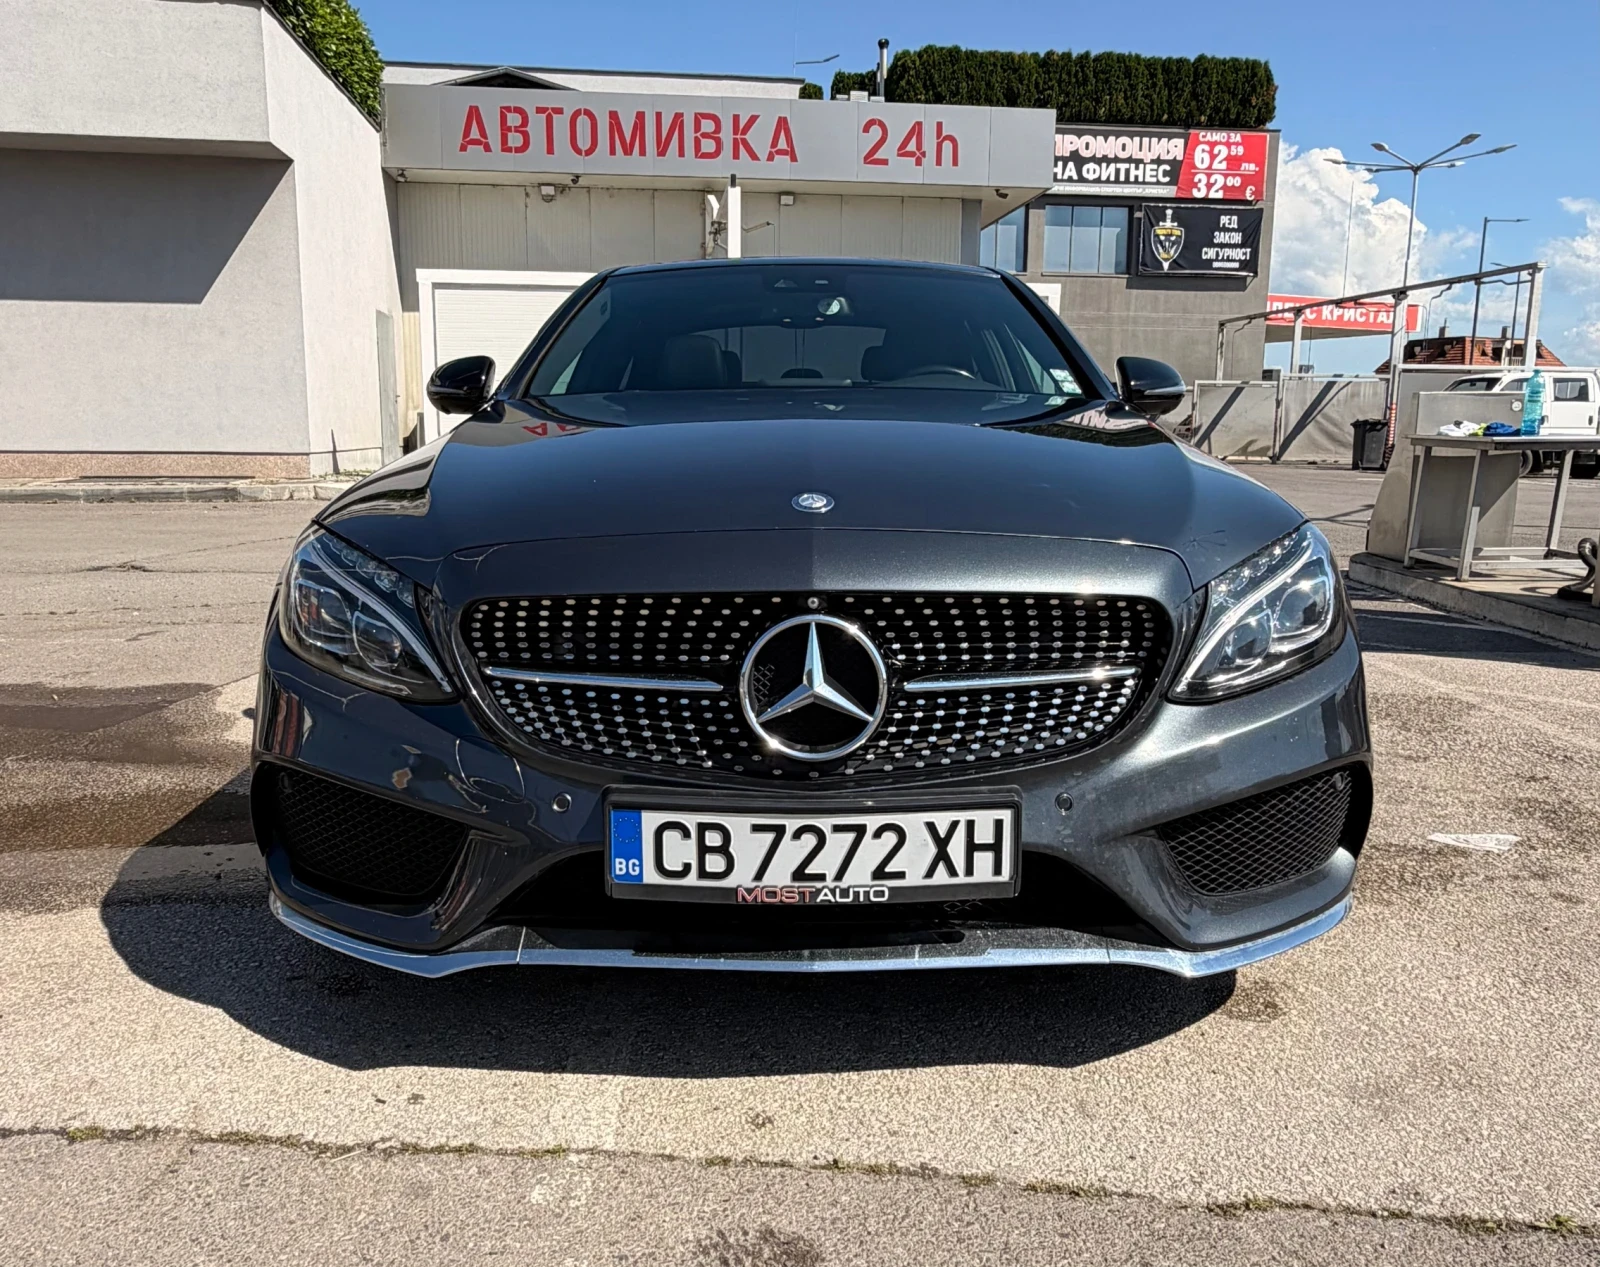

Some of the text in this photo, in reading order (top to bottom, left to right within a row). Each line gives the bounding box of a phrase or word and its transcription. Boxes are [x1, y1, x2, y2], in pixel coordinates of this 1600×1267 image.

[458, 104, 959, 167] АВТОМИВКА 24h
[1199, 131, 1242, 143] САМО ЗА
[1194, 144, 1229, 170] 62
[1082, 162, 1171, 183] ФИТНЕС
[1192, 173, 1225, 199] 32
[1246, 185, 1256, 201] €
[1220, 215, 1238, 229] РЕД
[1213, 231, 1242, 244] ЗАКОН
[1201, 247, 1251, 260] СИГУРНОСТ
[615, 818, 1005, 882] BG CB 7272 XH
